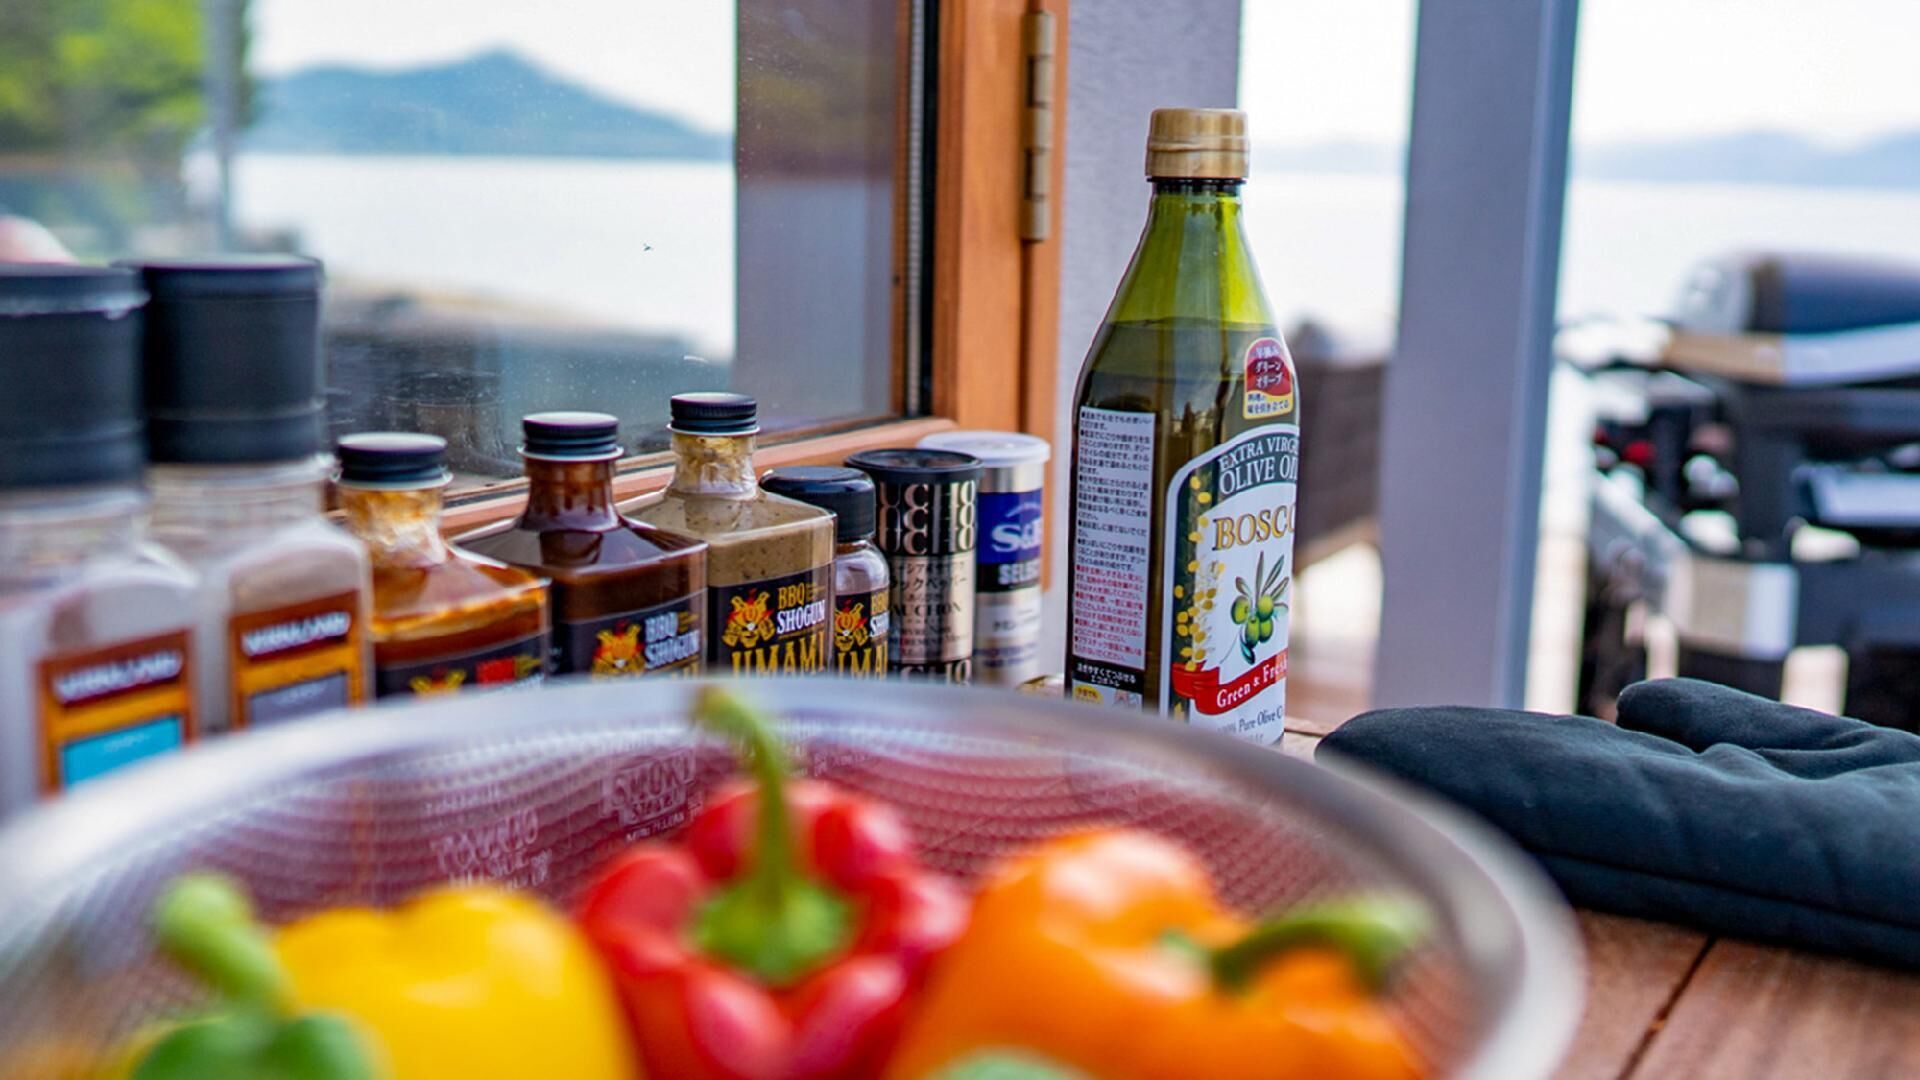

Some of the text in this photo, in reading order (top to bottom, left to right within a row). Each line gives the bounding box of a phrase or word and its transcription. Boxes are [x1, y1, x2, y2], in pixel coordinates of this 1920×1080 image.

[1217, 440, 1264, 473] EXTRA
[1220, 456, 1276, 495] OLIVE
[777, 583, 806, 610] BBQ
[645, 612, 679, 643] BBQ
[776, 600, 826, 634] SHOGUN
[644, 629, 700, 669] SHOGUN
[1216, 683, 1251, 708] Green
[1257, 708, 1276, 725] Olive
